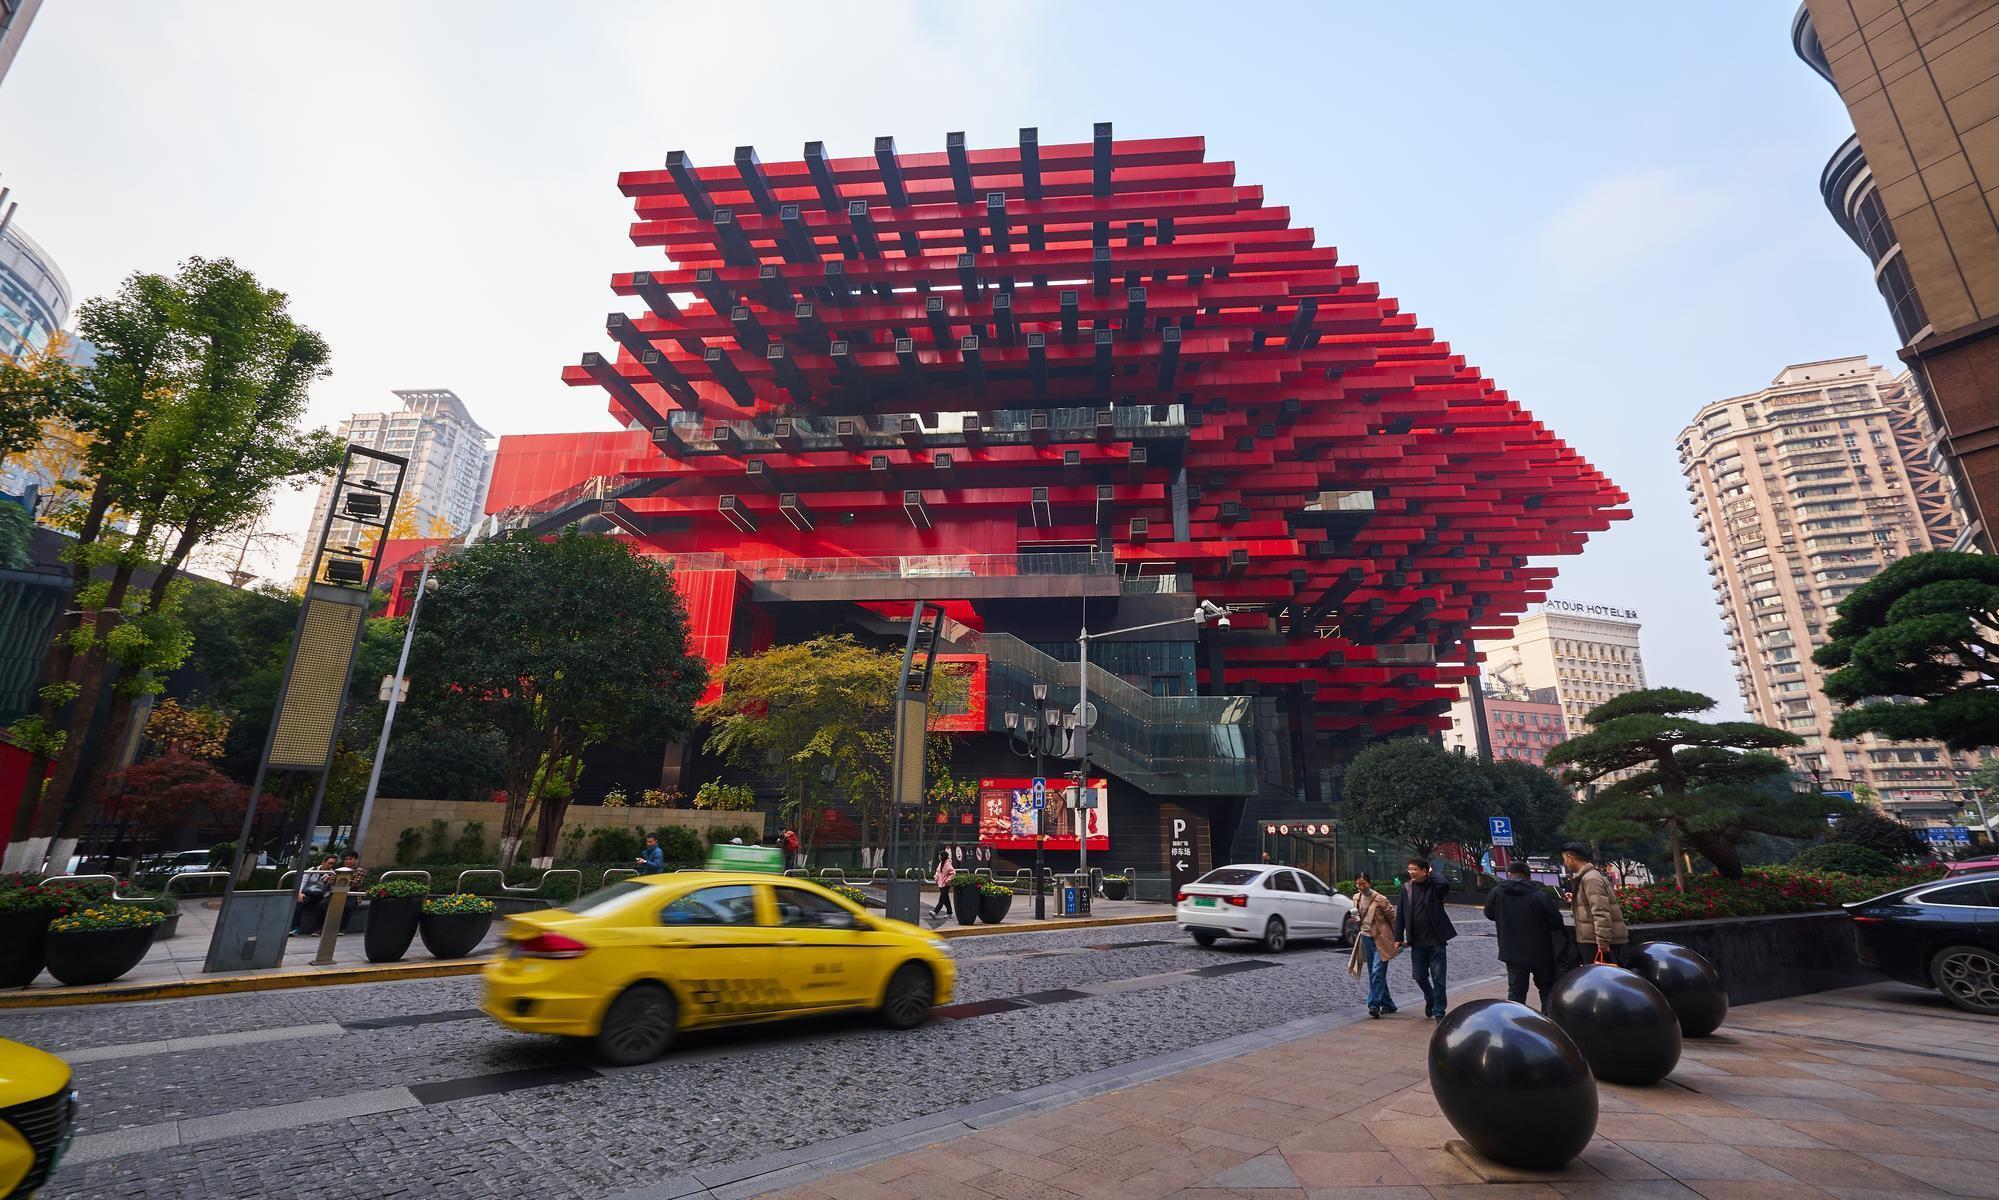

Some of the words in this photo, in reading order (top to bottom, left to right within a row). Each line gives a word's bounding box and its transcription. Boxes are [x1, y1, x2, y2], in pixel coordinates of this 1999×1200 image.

[1546, 600, 1584, 612] ATOUR
[1587, 605, 1624, 618] HOTEL
[1173, 819, 1186, 839] P
[1493, 820, 1505, 834] P
